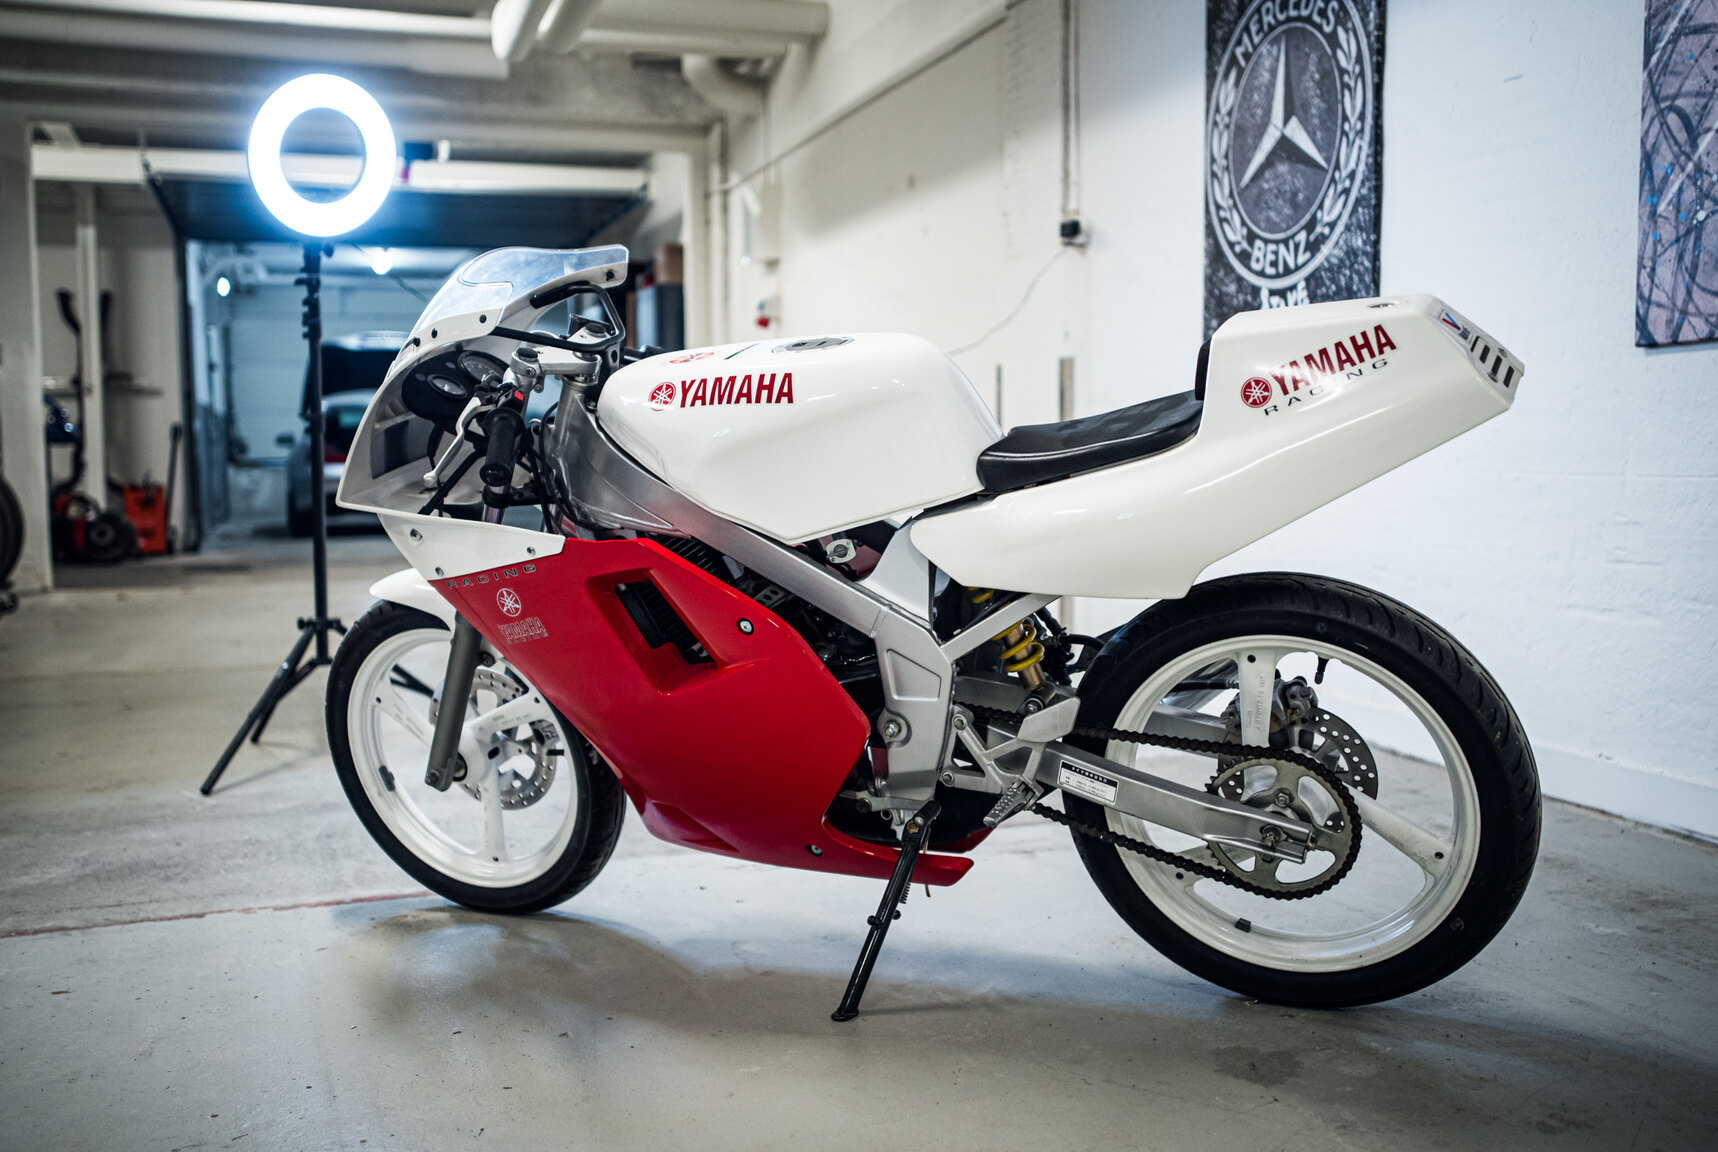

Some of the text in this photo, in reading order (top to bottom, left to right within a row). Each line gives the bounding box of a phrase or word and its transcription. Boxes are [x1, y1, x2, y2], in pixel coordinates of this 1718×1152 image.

[1234, 0, 1339, 68] MERCEDES
[1250, 231, 1312, 276] BENZ
[1269, 324, 1397, 396] YAMAHA
[680, 373, 793, 408] YAMAHA
[446, 563, 537, 588] RACING
[498, 616, 546, 641] YAMAHA
